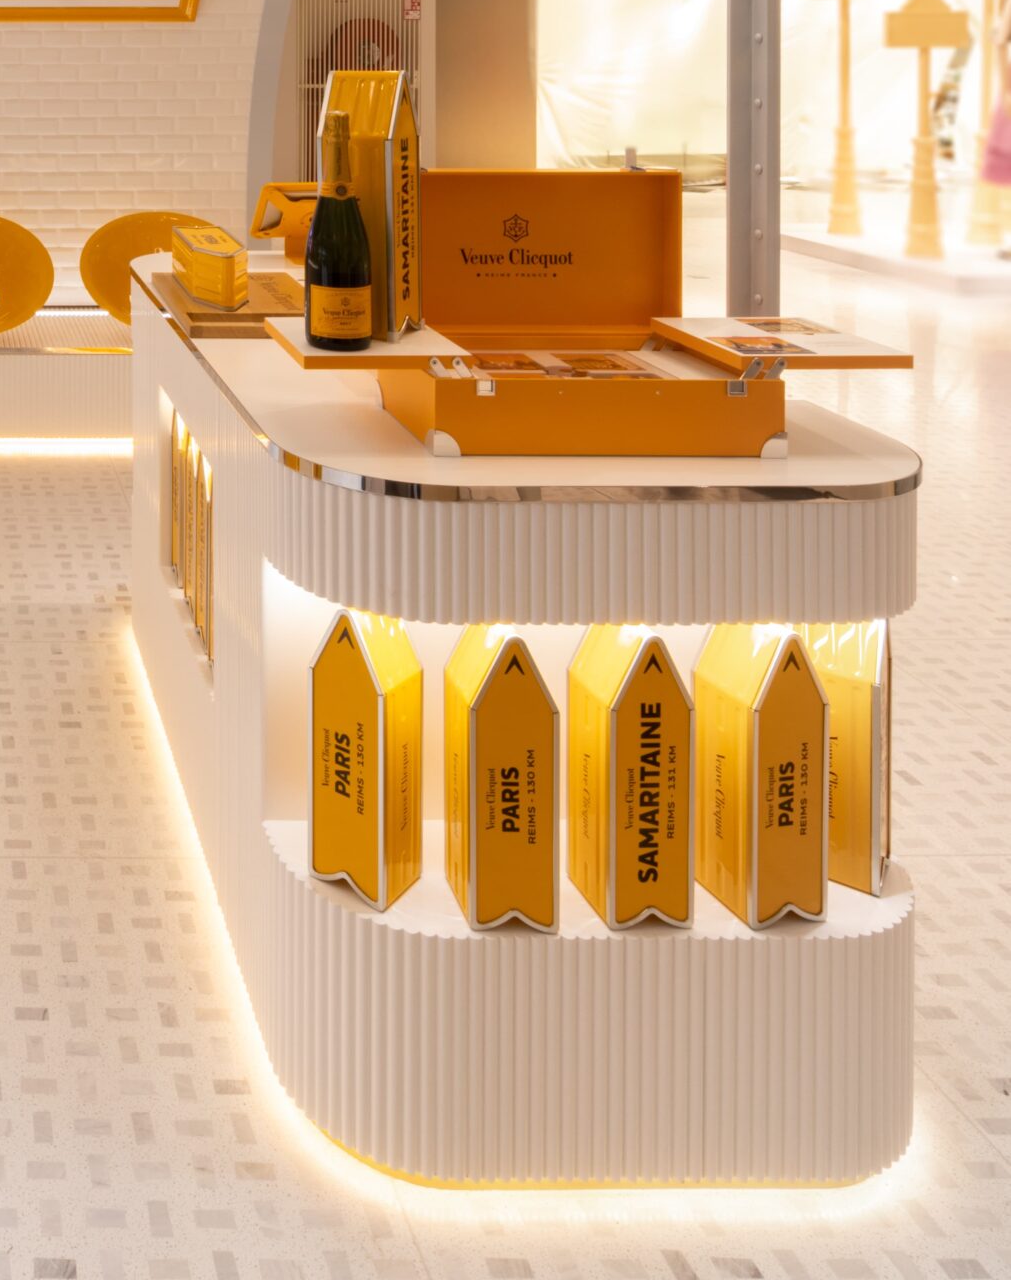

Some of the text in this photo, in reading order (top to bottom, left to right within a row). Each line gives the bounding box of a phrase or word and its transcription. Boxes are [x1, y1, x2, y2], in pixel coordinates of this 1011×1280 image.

[400, 137, 410, 301] SAMARITAINE
[460, 248, 573, 269] Veuve Clicquot
[356, 722, 364, 741] KM
[356, 743, 364, 767] 130
[527, 749, 535, 768] KM
[668, 745, 676, 763] KM
[801, 742, 809, 760] KM
[334, 731, 350, 798] PARIS
[800, 763, 808, 786] 130
[527, 771, 536, 794] 130
[668, 767, 676, 790] 131
[501, 766, 520, 833] PARIS
[638, 702, 661, 883] SAMARITAINE
[778, 761, 795, 827] PARIS
[528, 806, 536, 845] REIMS
[667, 802, 676, 839] REIMS
[800, 798, 808, 836] REIMS
